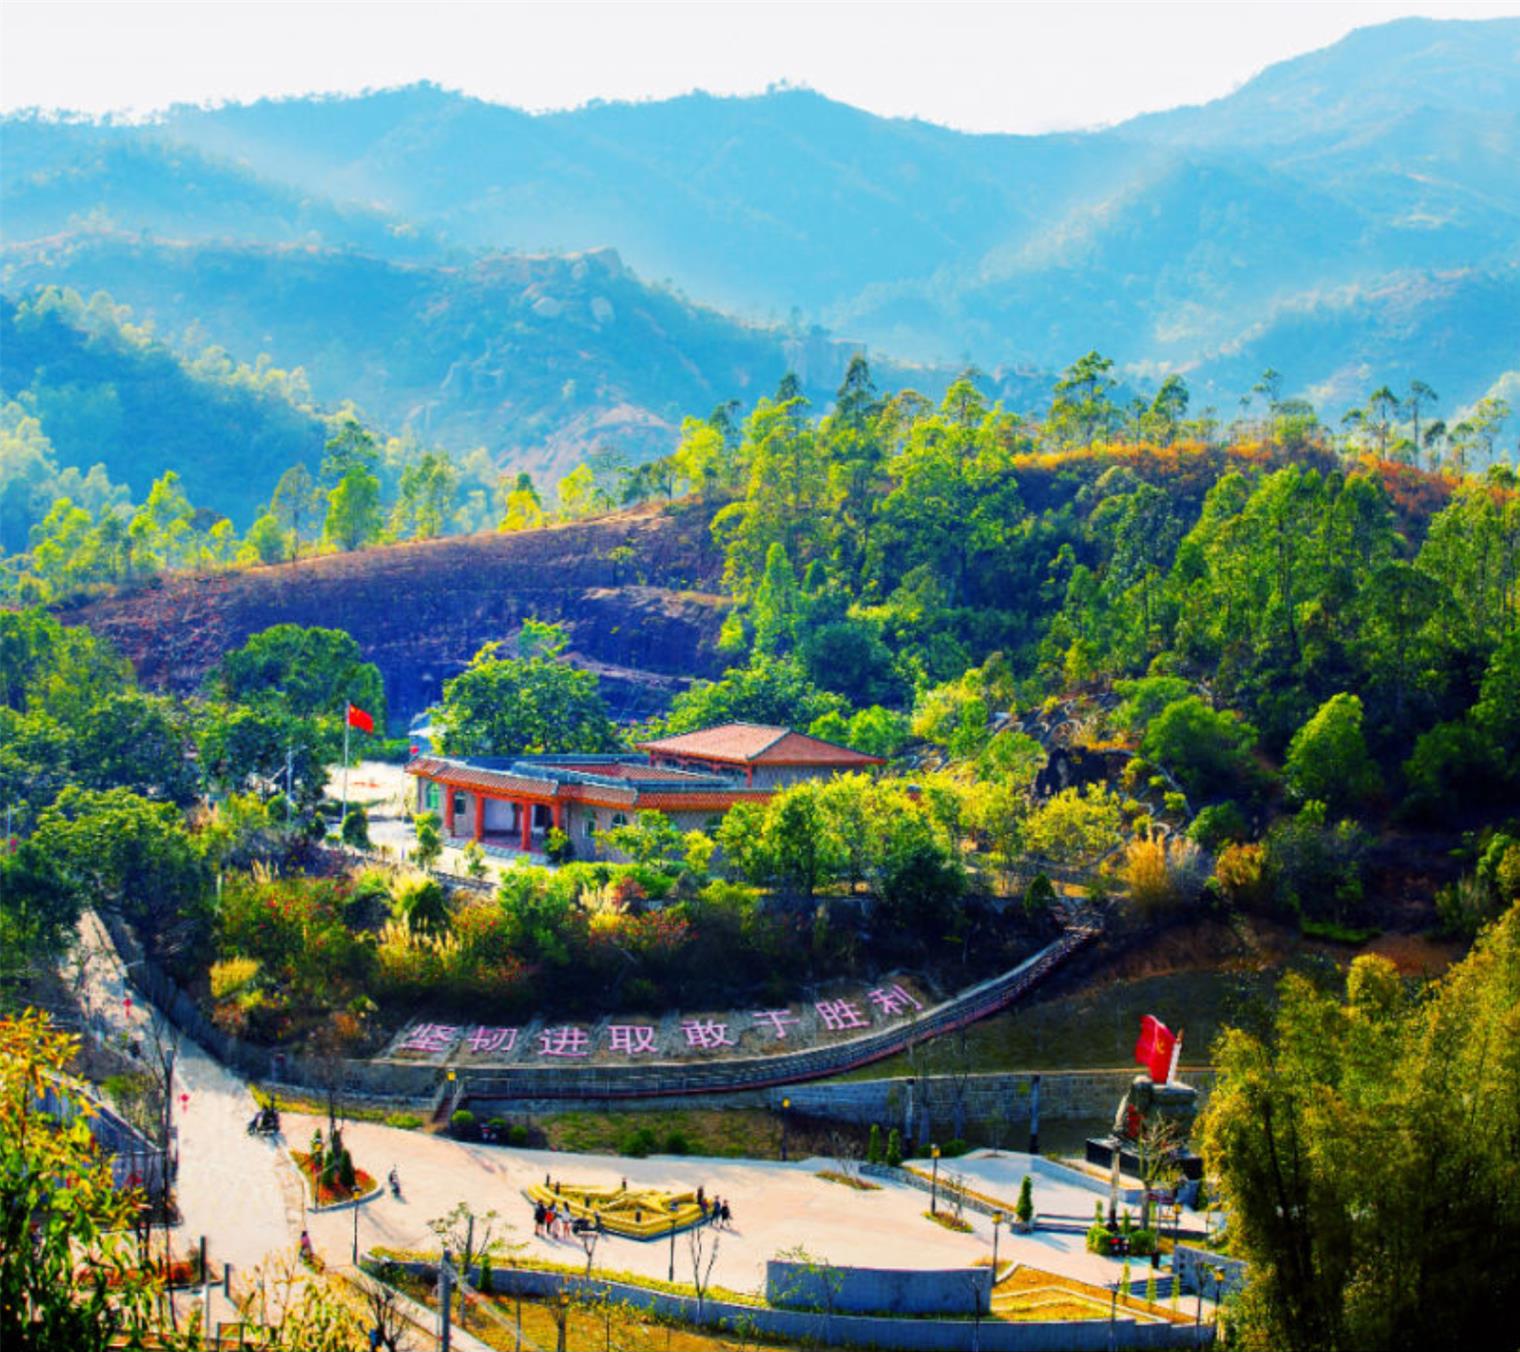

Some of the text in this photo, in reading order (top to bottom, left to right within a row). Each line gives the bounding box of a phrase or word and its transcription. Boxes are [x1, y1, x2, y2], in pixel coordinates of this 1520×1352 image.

[402, 985, 924, 1057] 坚韧进取敢于胜利
